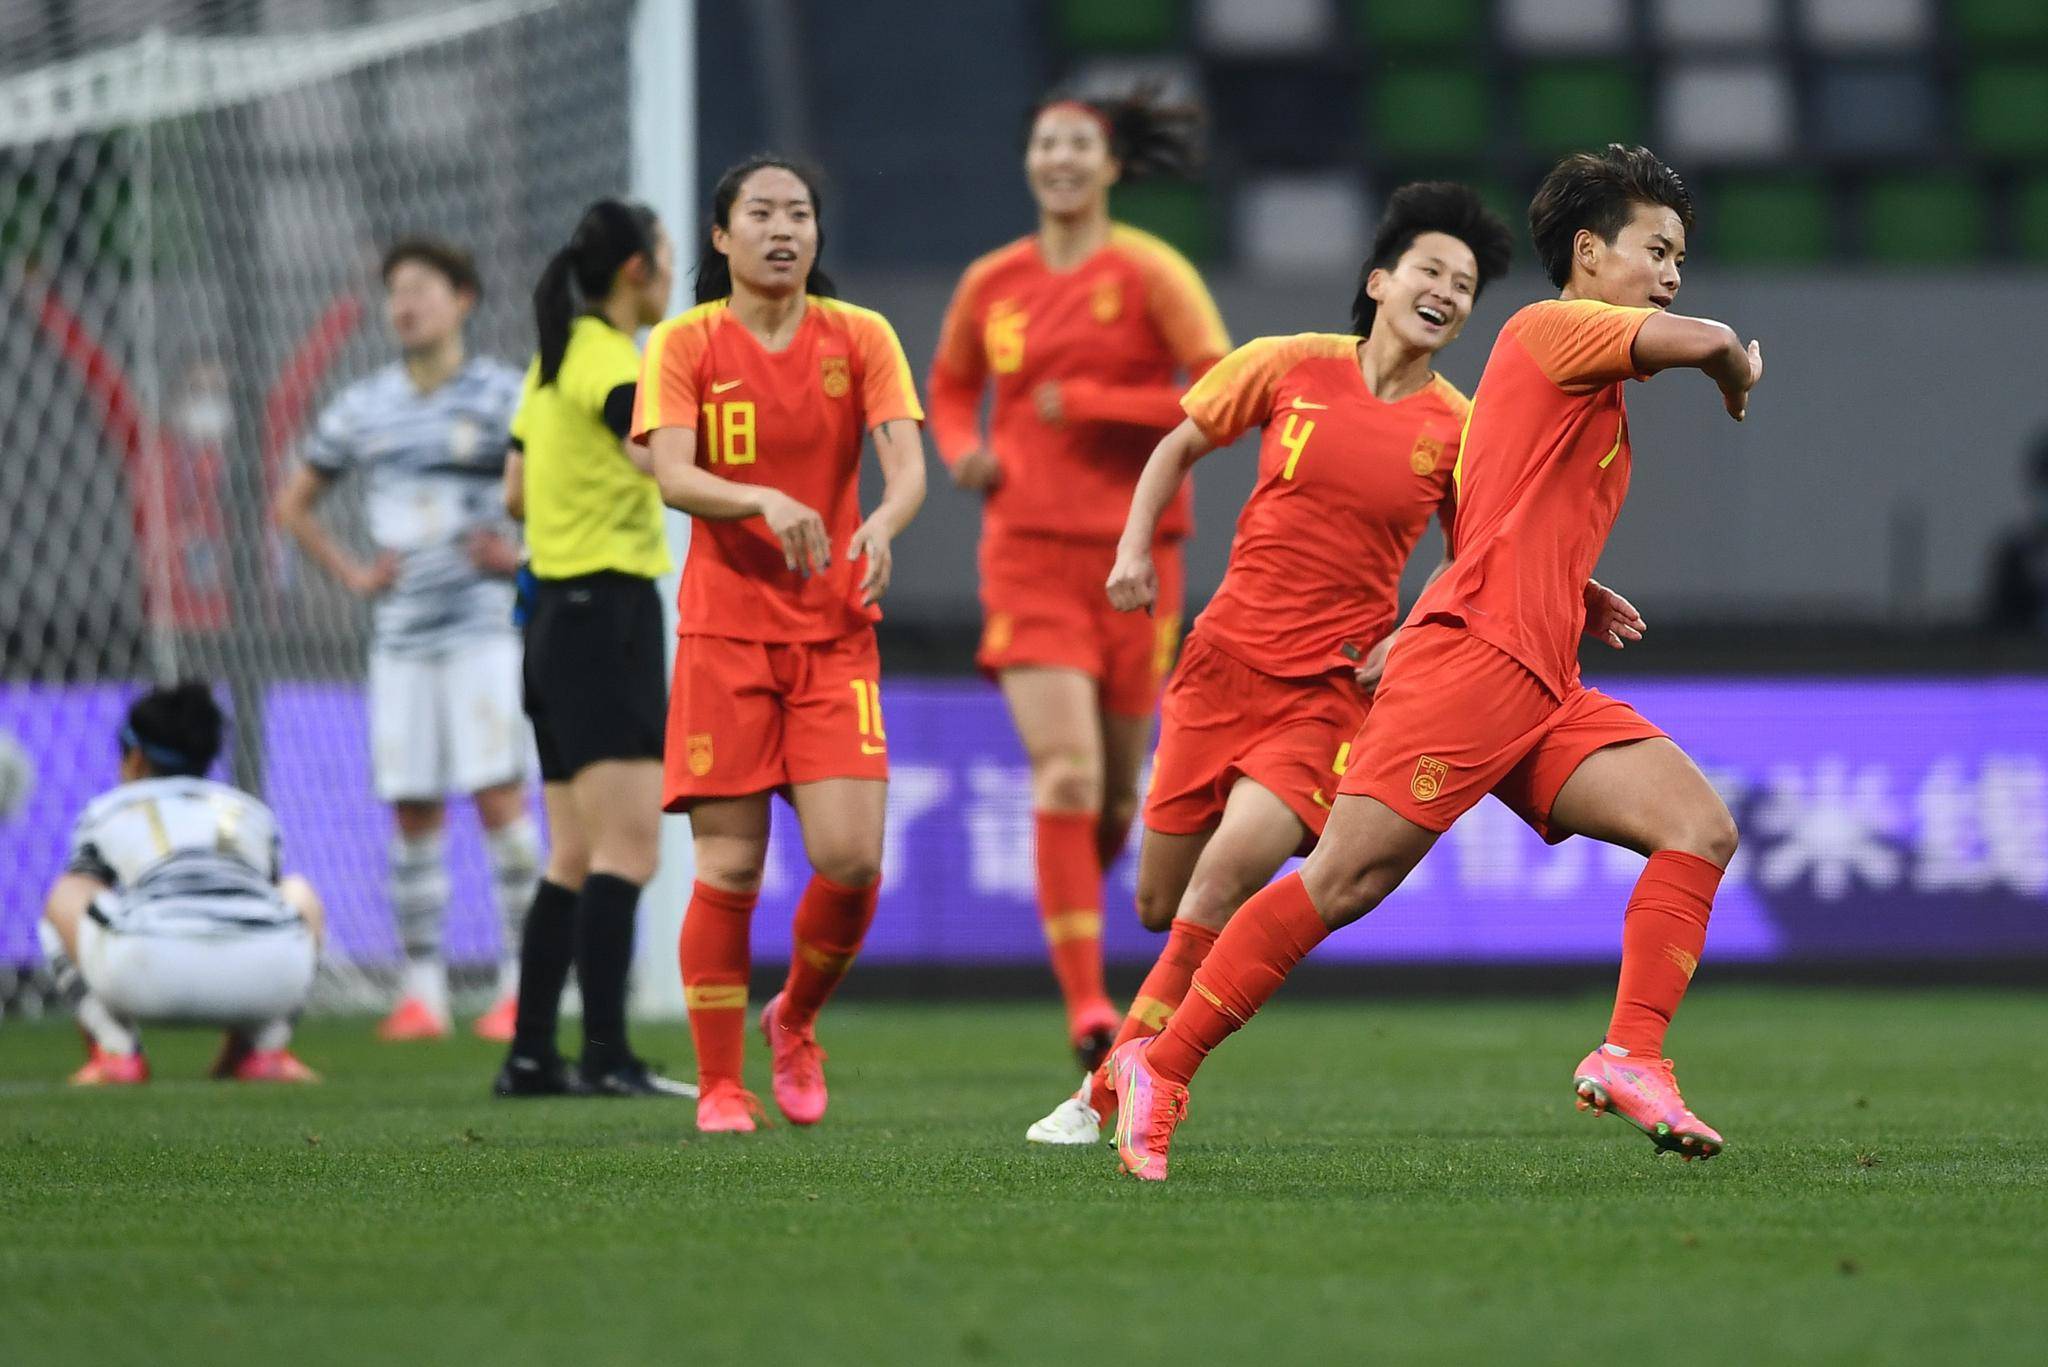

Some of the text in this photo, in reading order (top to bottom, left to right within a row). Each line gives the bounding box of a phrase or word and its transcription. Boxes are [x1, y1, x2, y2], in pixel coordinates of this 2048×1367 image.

[703, 402, 756, 465] 18
[1281, 413, 1316, 481] 4
[1420, 758, 1445, 774] CFA
